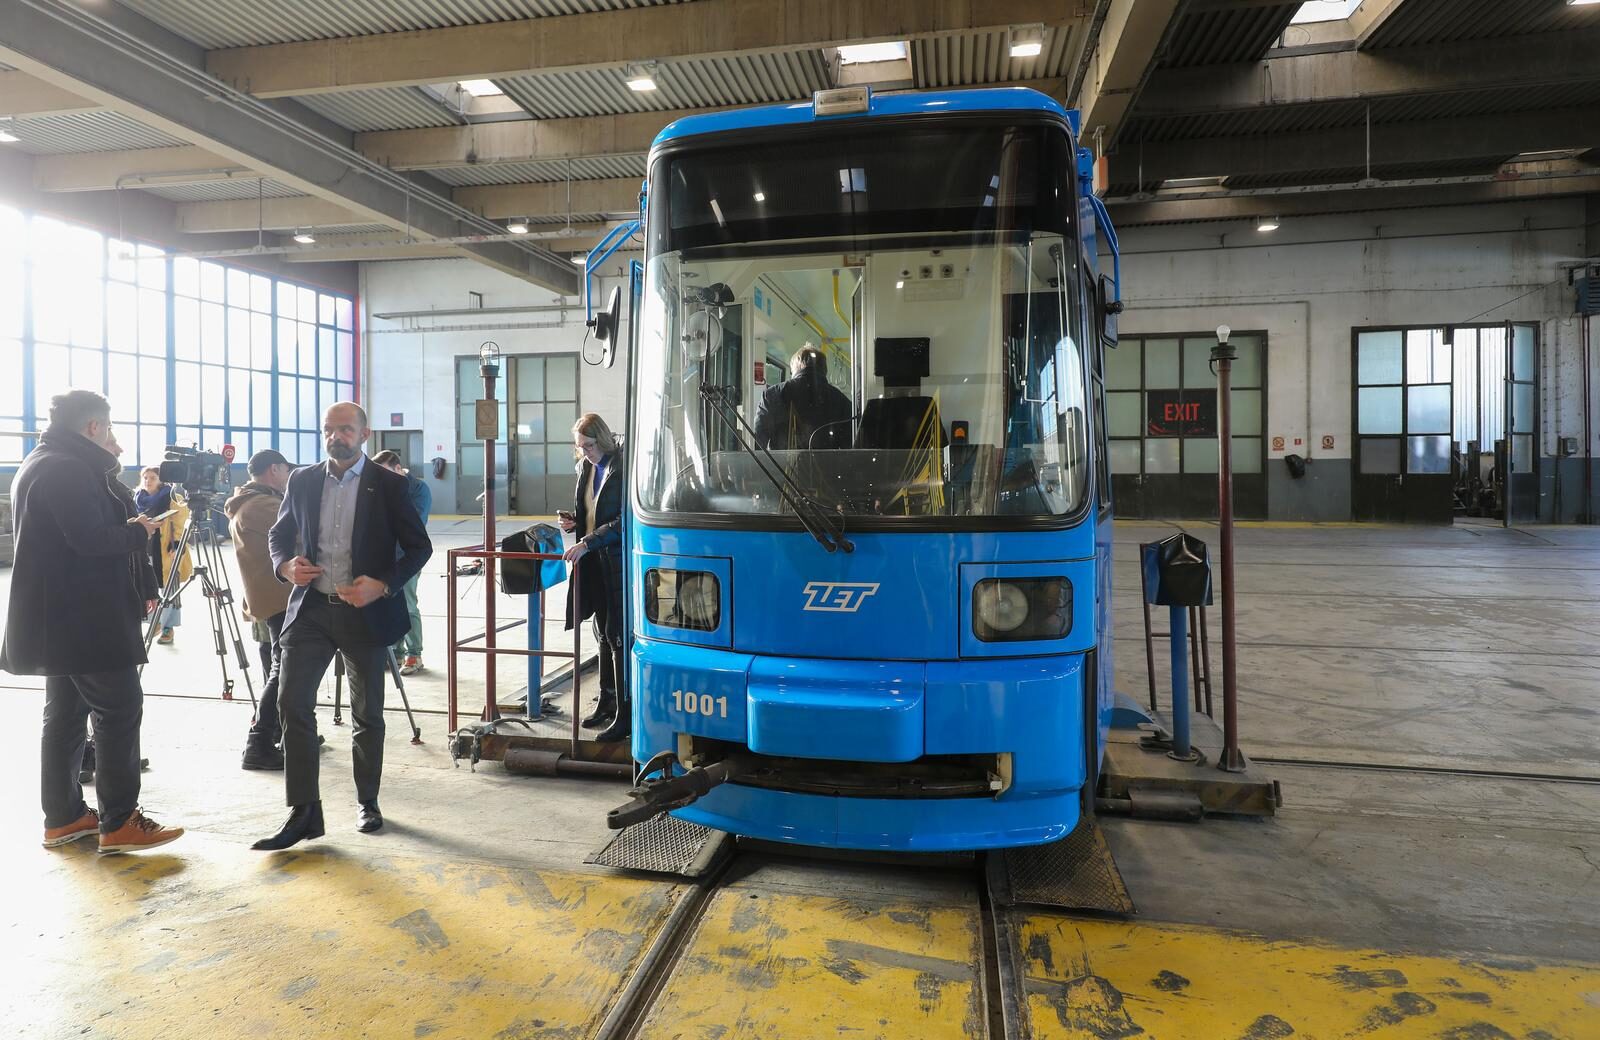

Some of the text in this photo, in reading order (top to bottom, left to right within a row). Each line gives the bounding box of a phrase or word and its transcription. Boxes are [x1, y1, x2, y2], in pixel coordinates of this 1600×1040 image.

[1164, 403, 1200, 421] EXIT
[802, 581, 880, 612] ZET
[672, 690, 727, 718] 1001
